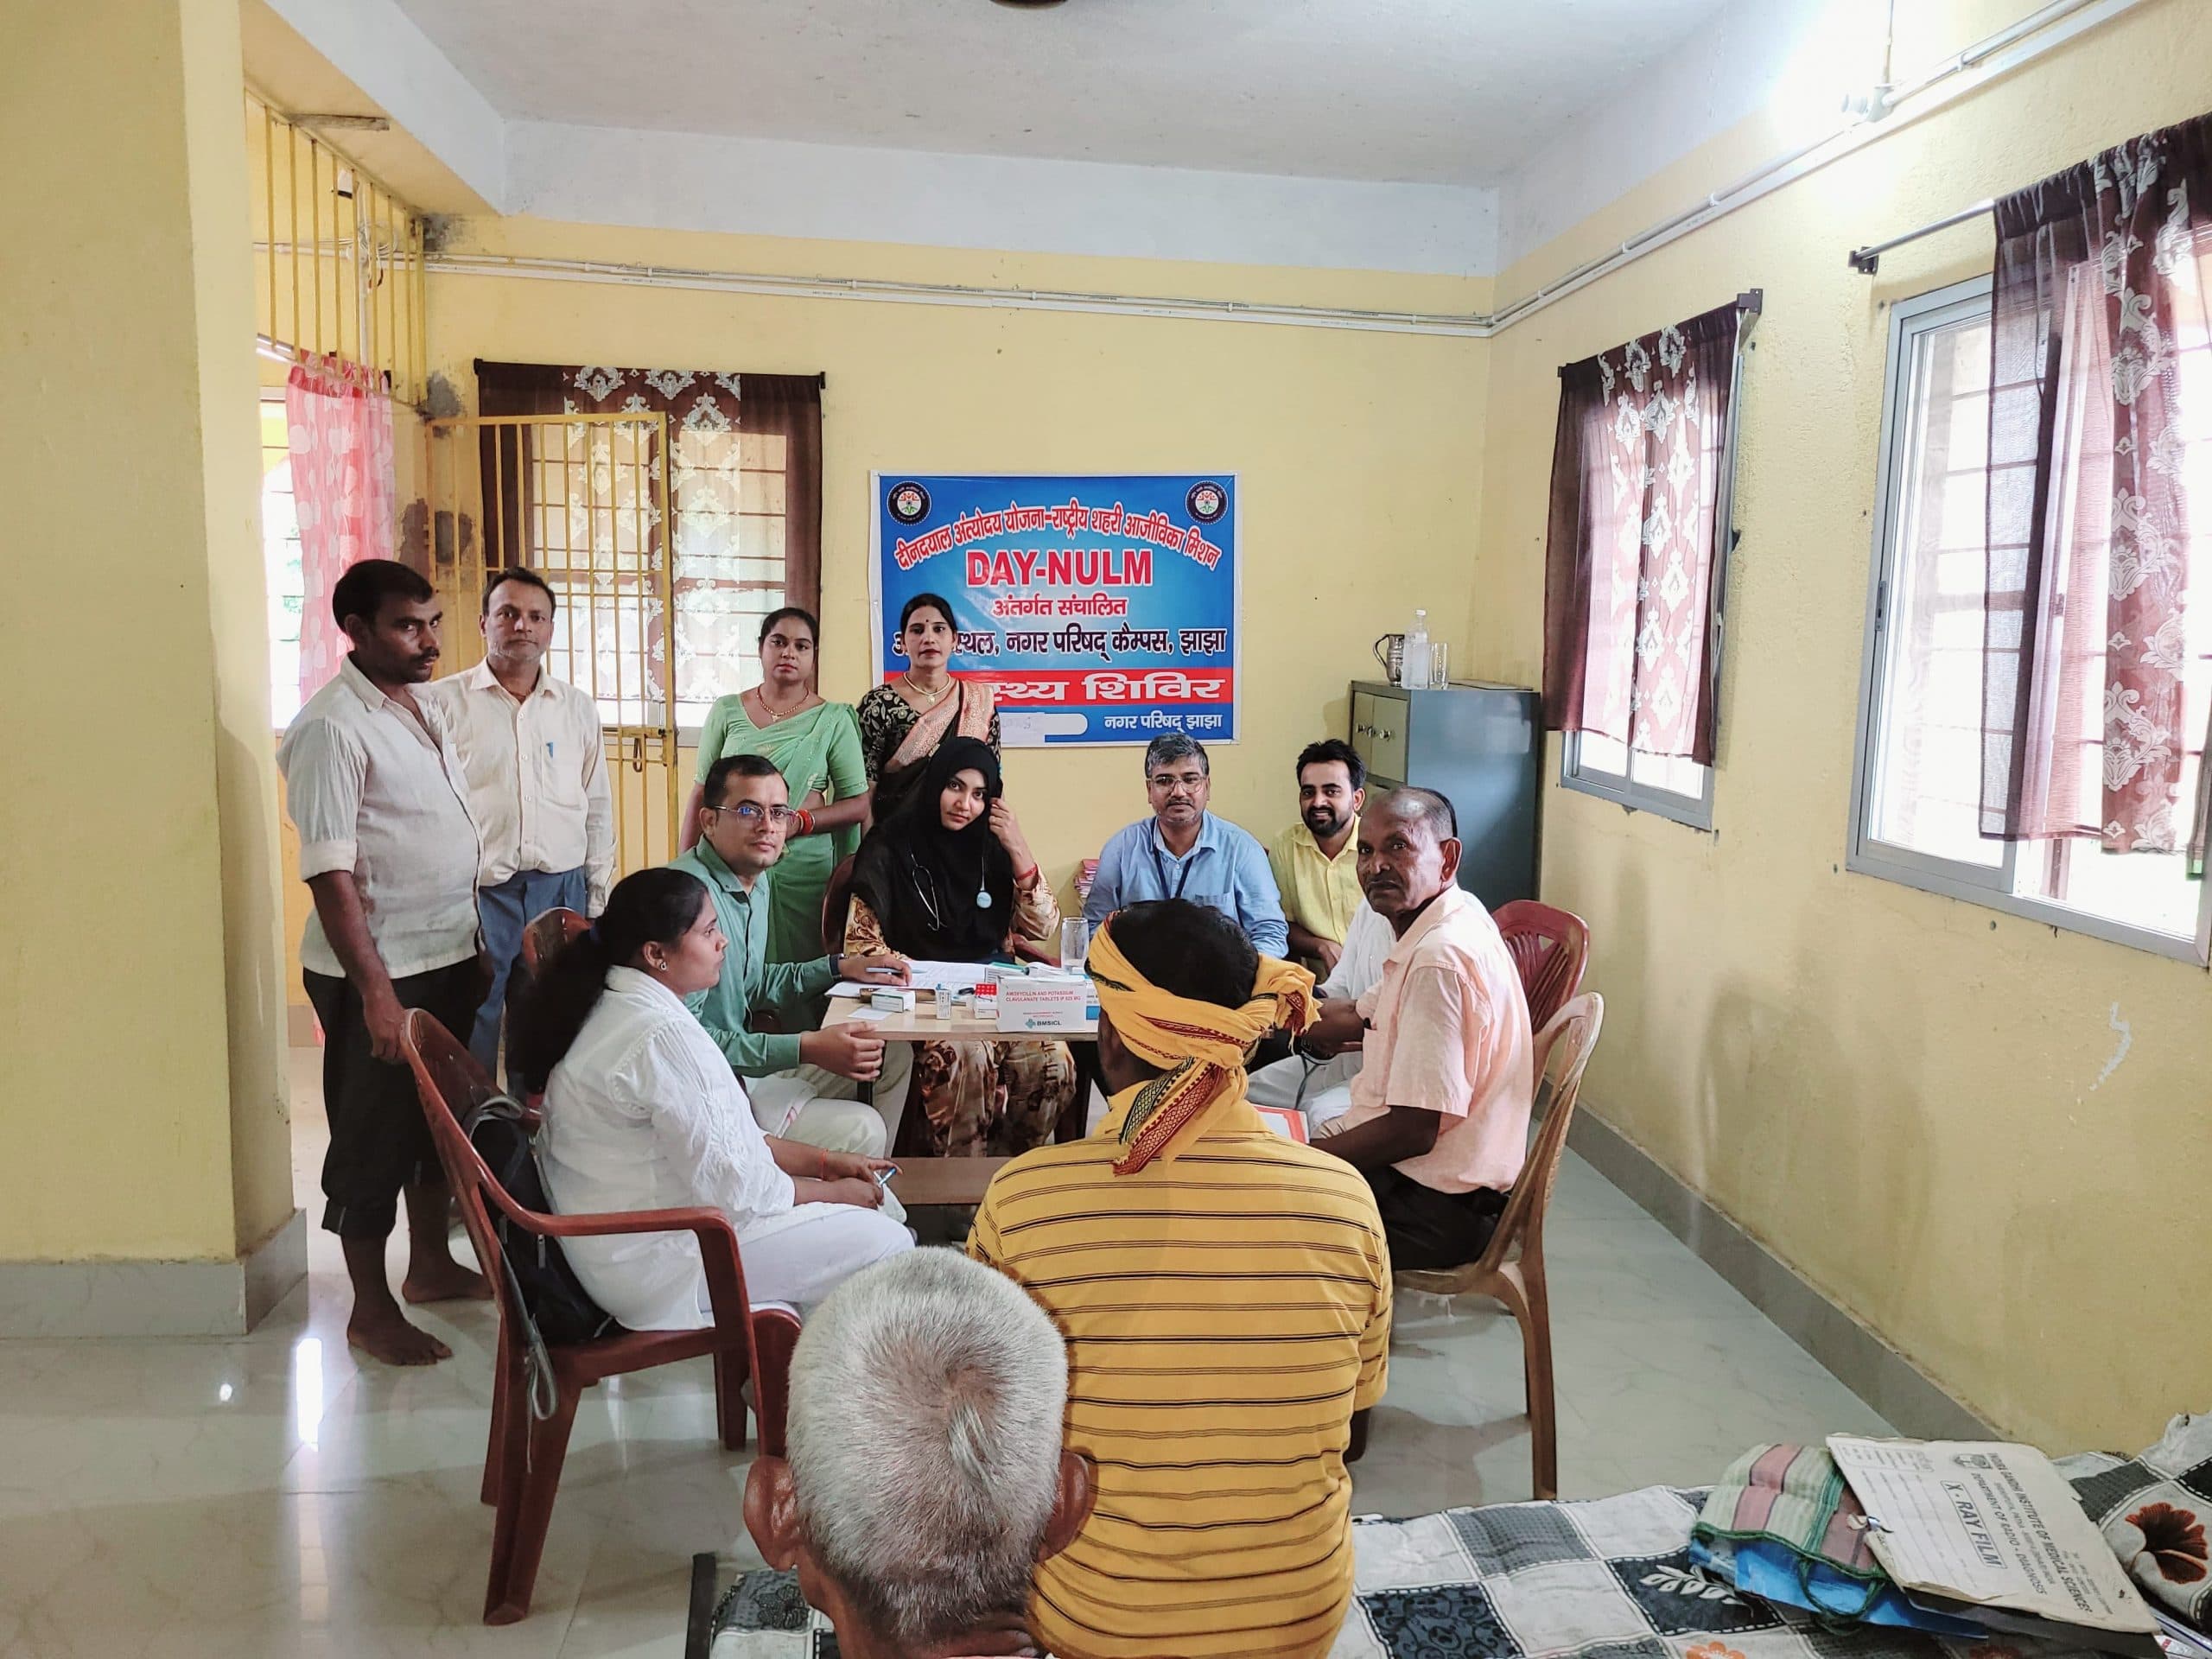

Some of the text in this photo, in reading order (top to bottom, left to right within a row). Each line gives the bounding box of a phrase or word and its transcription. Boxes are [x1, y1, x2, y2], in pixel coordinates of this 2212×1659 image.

[895, 525, 952, 569] दीनदयाल
[954, 511, 1002, 544] अंत्योदय
[1091, 504, 1122, 533] शहरी
[1125, 513, 1185, 550] आजीविका
[1185, 528, 1220, 568] मिशन
[967, 551, 1152, 586] DAY-NULM
[993, 593, 1127, 616] अंतर्गत संचालित
[1006, 632, 1048, 653] नगर
[1054, 622, 1111, 661] परिषद्
[1112, 622, 1173, 654] कैम्पस,
[1179, 629, 1226, 655] झाझा
[1081, 671, 1225, 701] शिविर
[1105, 715, 1138, 729] नगर
[1185, 714, 1223, 729] झाझा
[2015, 1493, 2044, 1529] INSTITUTE
[1955, 1501, 1984, 1529] RAY
[1971, 1532, 2003, 1566] FILM
[1971, 1473, 2001, 1510] DEPARTMENT
[1994, 1511, 2008, 1522] OF
[2016, 1554, 2048, 1595] DIAGNOSIS
[2036, 1530, 2050, 1541] OF
[2042, 1541, 2069, 1574] MEDICAL
